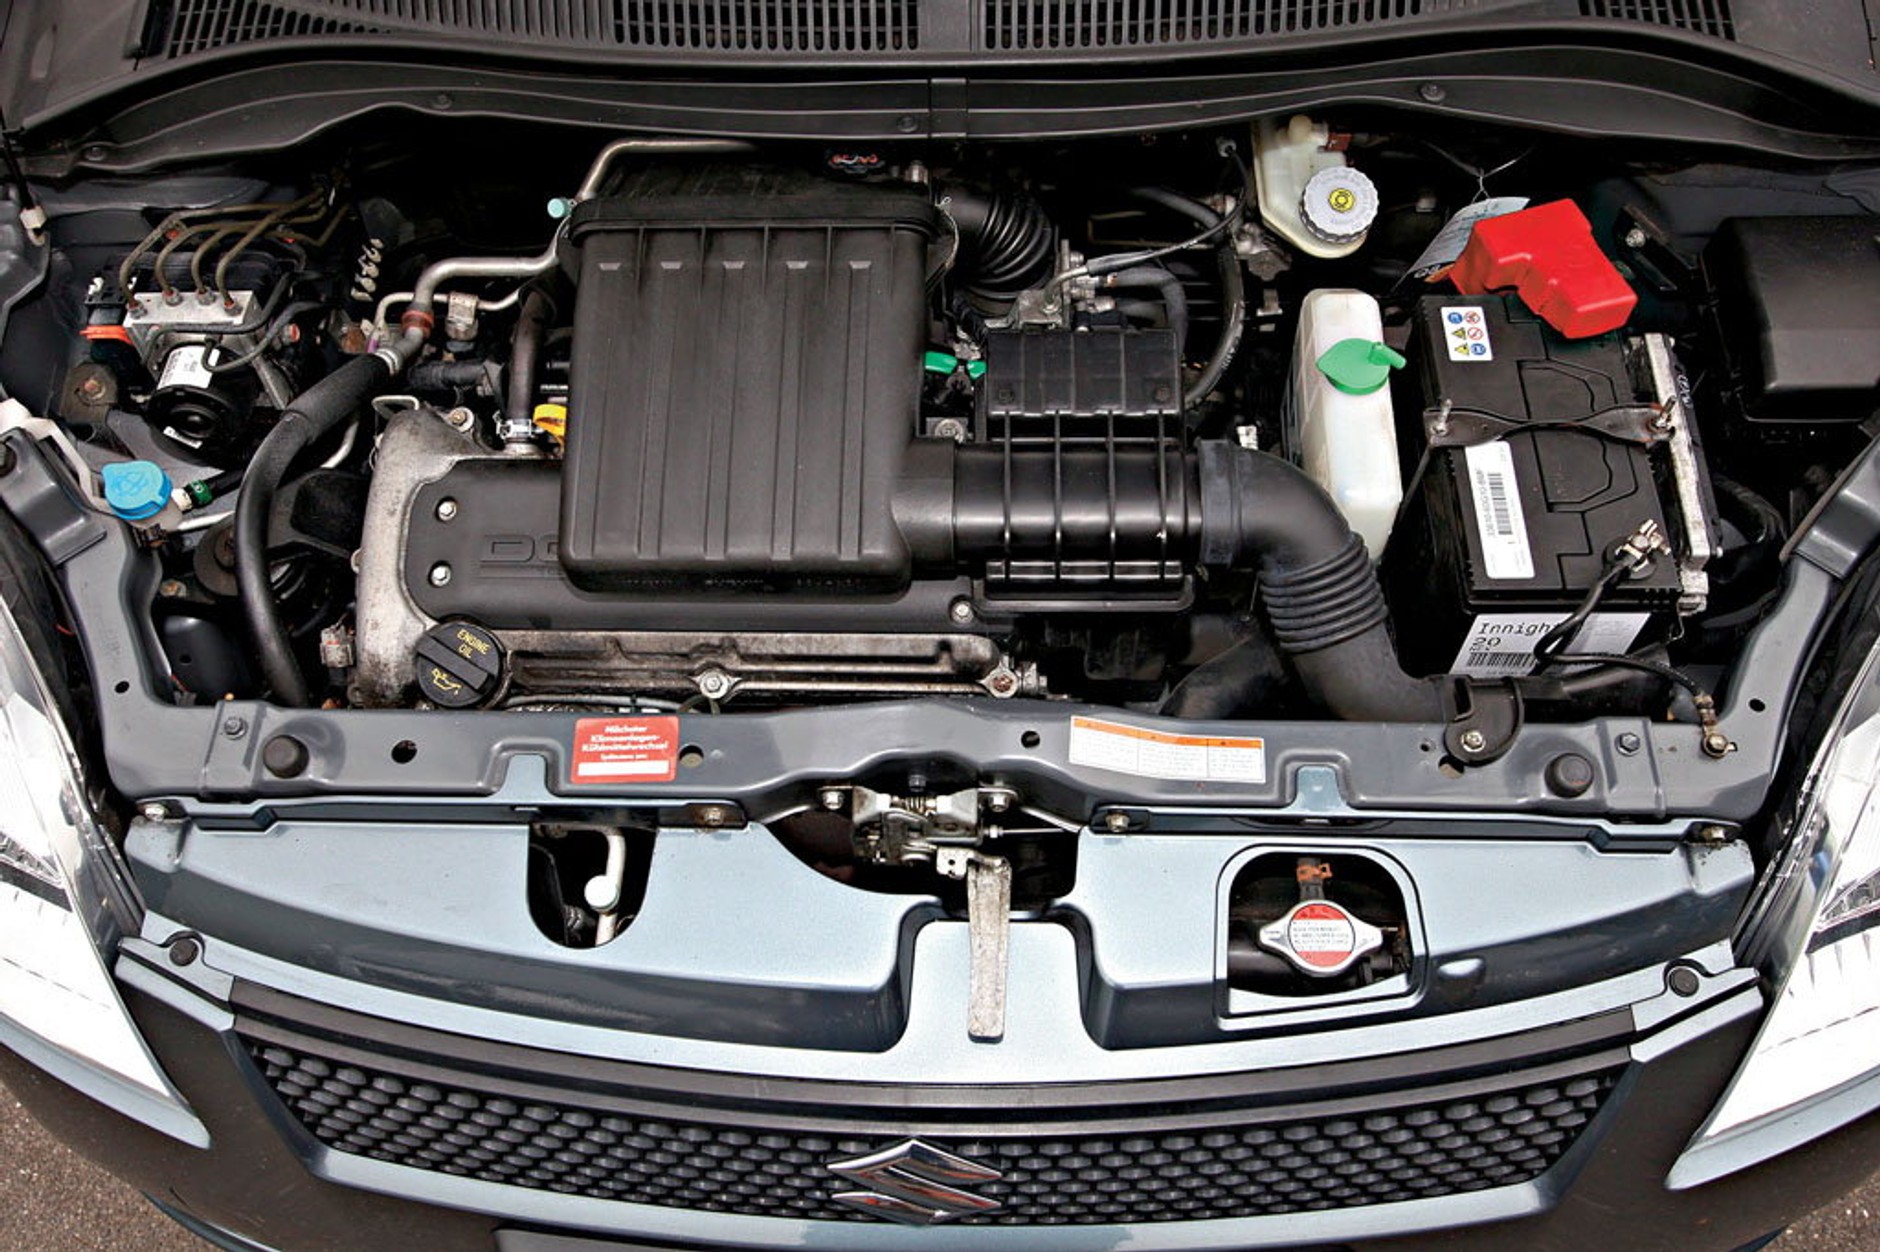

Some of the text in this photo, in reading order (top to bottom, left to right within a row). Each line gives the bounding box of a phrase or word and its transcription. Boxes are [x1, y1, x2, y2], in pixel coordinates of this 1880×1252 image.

[1477, 622, 1557, 637] Innigh
[457, 629, 491, 655] ENGINE
[459, 643, 473, 658] OIL
